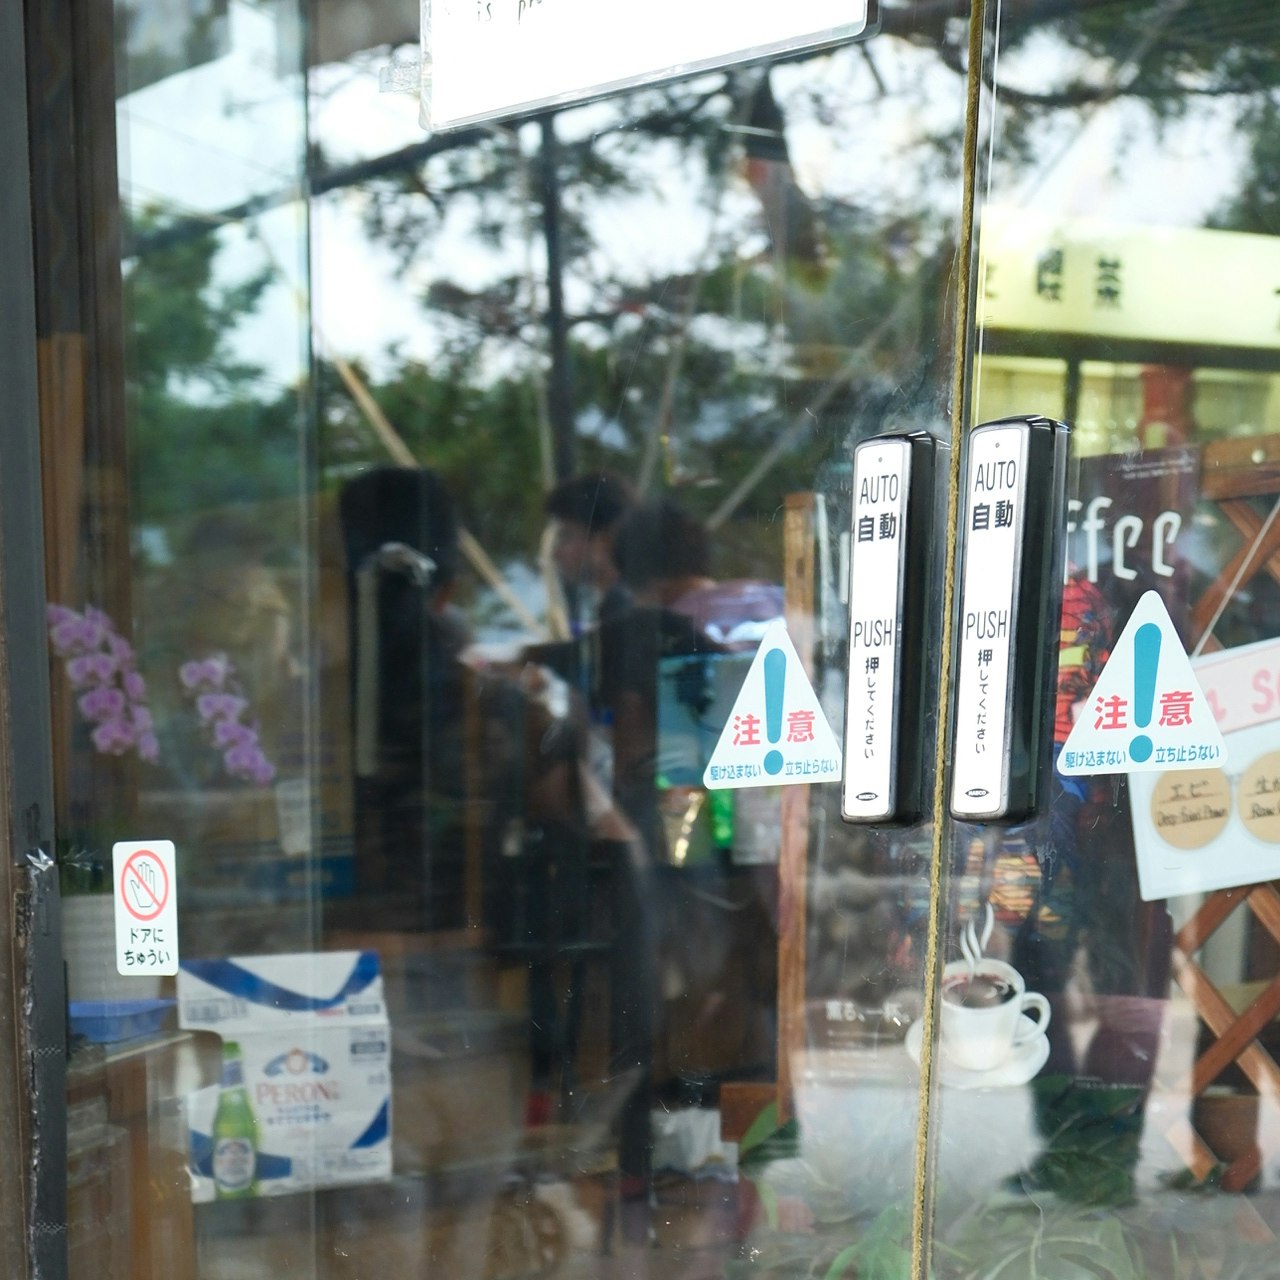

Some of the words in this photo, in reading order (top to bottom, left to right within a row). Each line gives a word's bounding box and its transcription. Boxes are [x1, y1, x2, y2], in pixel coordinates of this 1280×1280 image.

[859, 473, 899, 505] AUTO
[974, 459, 1017, 492] AUTO
[857, 513, 897, 543] 自動
[971, 499, 1014, 532] 自動
[854, 617, 893, 649] PUSH
[966, 609, 1007, 640] PUSH
[863, 656, 880, 759] 押してください
[974, 649, 993, 754] 押してください
[710, 763, 762, 781] 駆け込まない
[1065, 750, 1126, 768] 駆け込まない
[130, 927, 165, 944] ドアに
[123, 948, 170, 966] ちゅうい
